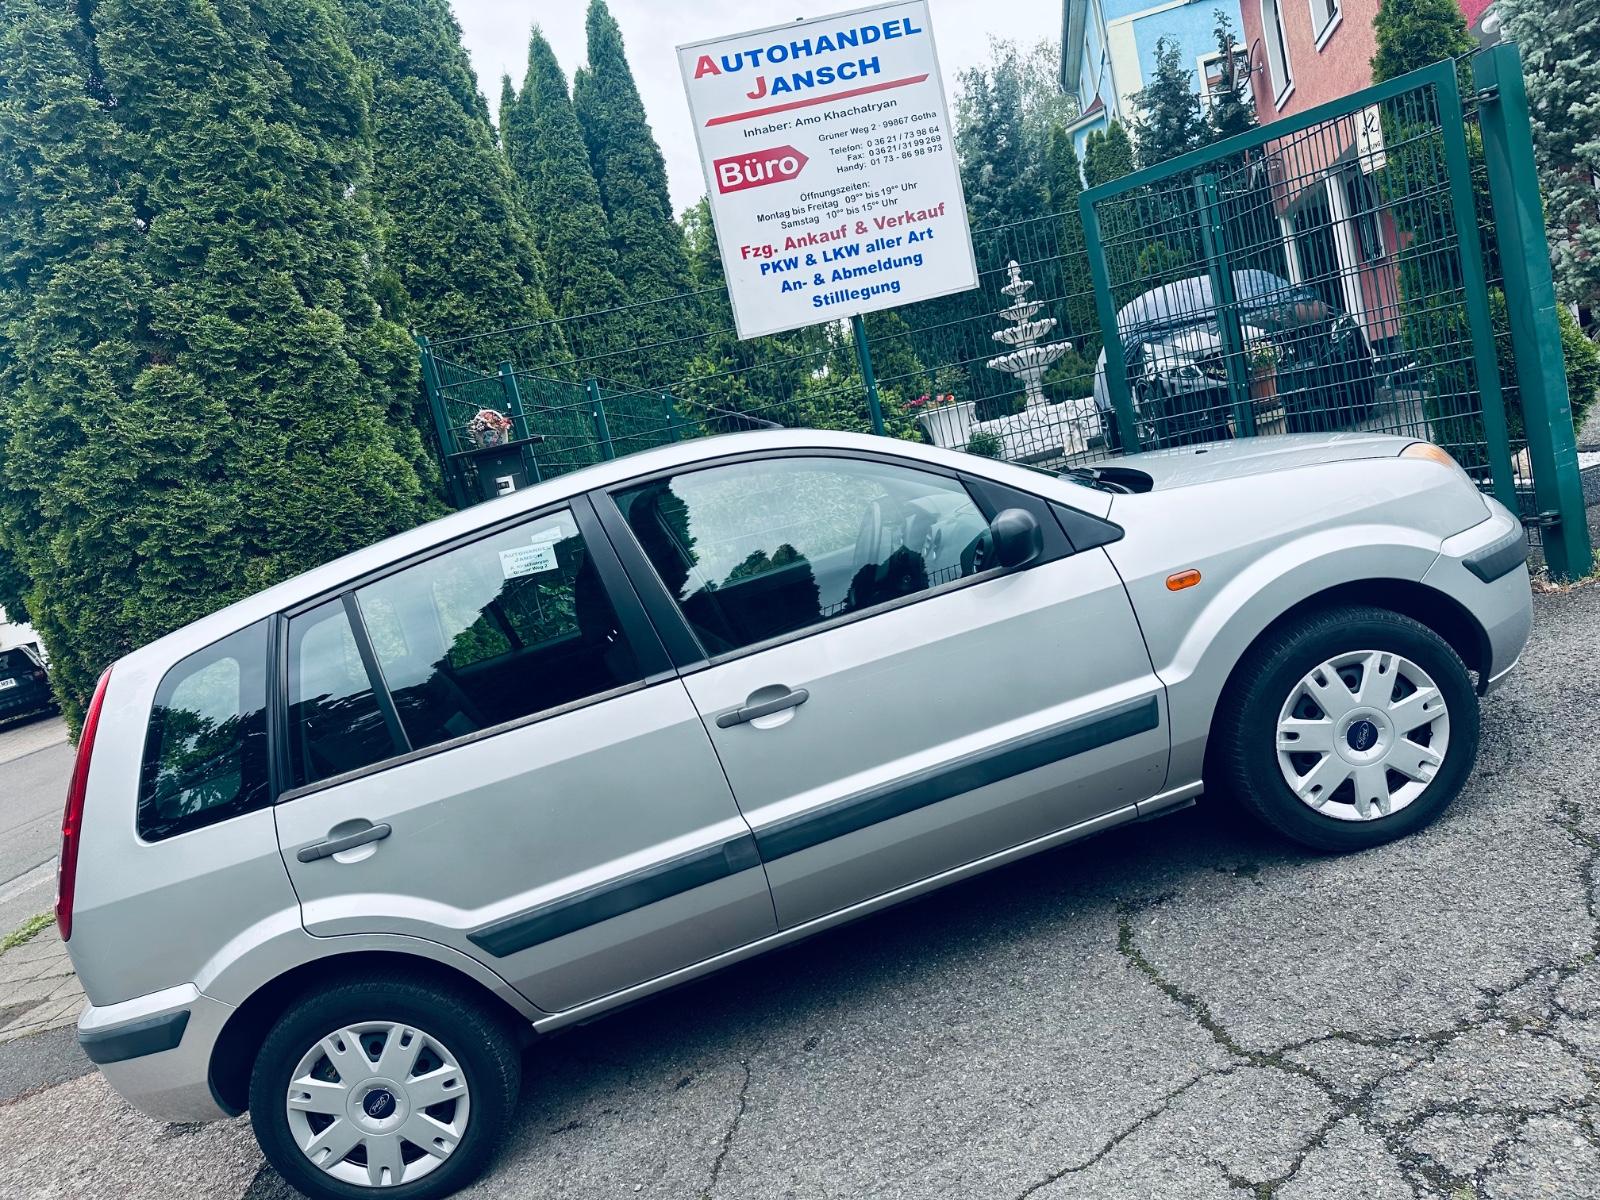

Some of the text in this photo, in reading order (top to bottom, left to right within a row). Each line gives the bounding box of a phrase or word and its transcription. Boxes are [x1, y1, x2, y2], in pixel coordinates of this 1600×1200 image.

[694, 17, 922, 80] AUTOHANDEL
[746, 55, 881, 100] JANSCH
[743, 99, 898, 138] Inhaber: Amo Khachatryan
[849, 126, 870, 135] Weg
[910, 111, 937, 122] Gotha
[828, 143, 863, 156] Telefon:
[846, 152, 865, 162] Fax:
[718, 156, 800, 188] Büro
[836, 162, 867, 174] Handy:
[756, 210, 791, 223] Montag
[791, 206, 806, 216] bis
[807, 200, 839, 212] Freitag
[864, 190, 880, 200] bis
[900, 182, 918, 192] Uhr
[799, 181, 871, 202] Öffnungszeiten:
[780, 215, 820, 230] Samstag
[845, 206, 860, 216] bis
[881, 198, 899, 208] Uhr
[740, 201, 945, 260] Fzg. Ankauf & Verkauf
[759, 227, 934, 276] PKW & LKW aller Art
[781, 253, 923, 294] An- & Abmeldung
[812, 280, 901, 308] Stilllegung
